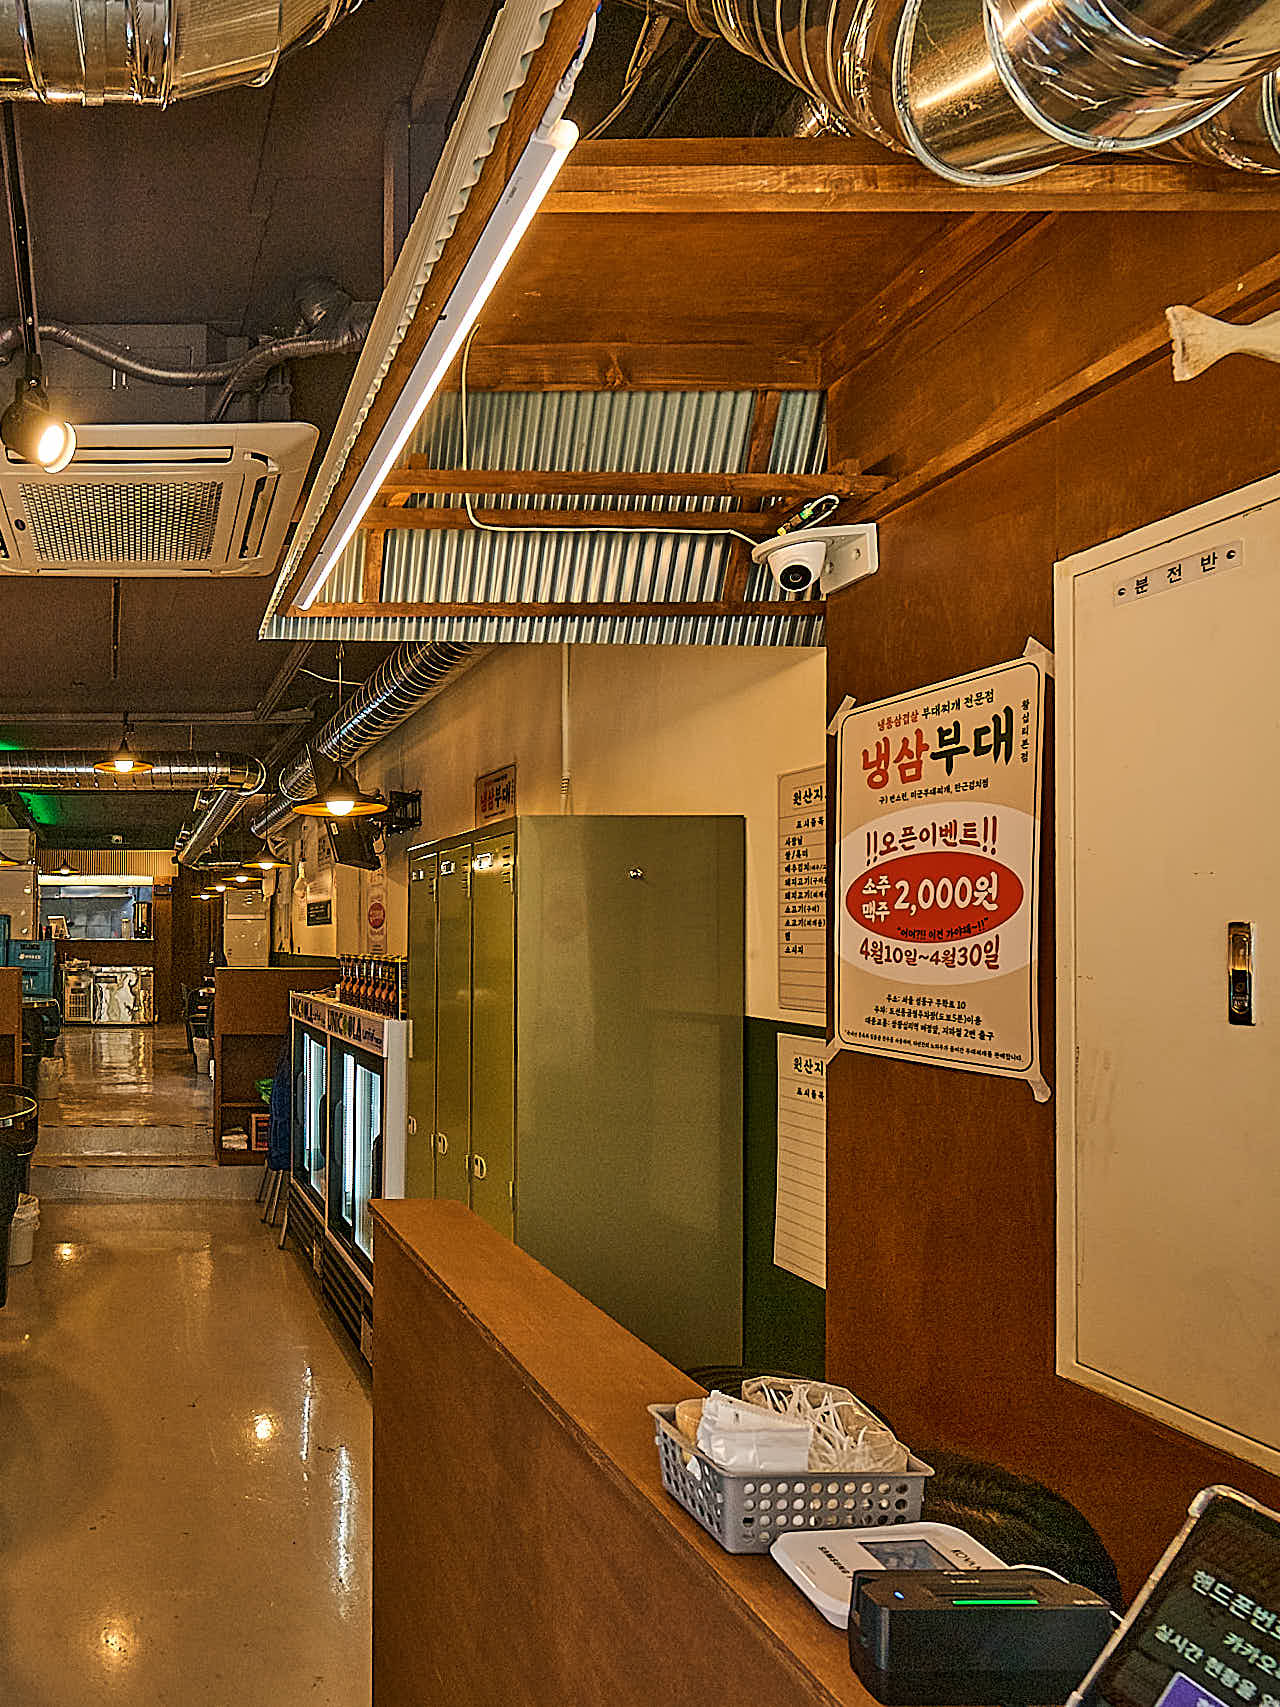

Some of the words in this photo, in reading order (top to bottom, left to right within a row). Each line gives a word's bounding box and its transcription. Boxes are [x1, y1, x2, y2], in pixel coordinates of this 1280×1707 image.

[877, 710, 919, 731] 냉동삼겹살
[922, 700, 961, 719] 부대찌개
[963, 689, 994, 708] 전문점
[862, 705, 1014, 790] 냉삼부대
[866, 815, 997, 866] !!오픈이벤트!!
[862, 875, 891, 896] 소주
[894, 871, 998, 916] 2,000원
[862, 901, 890, 923] 맥주
[859, 934, 1000, 970] 4월10일~4월30일
[957, 1001, 966, 1010] 10
[1154, 1622, 1204, 1665] 실시간
[1223, 1631, 1280, 1681] 카카오
